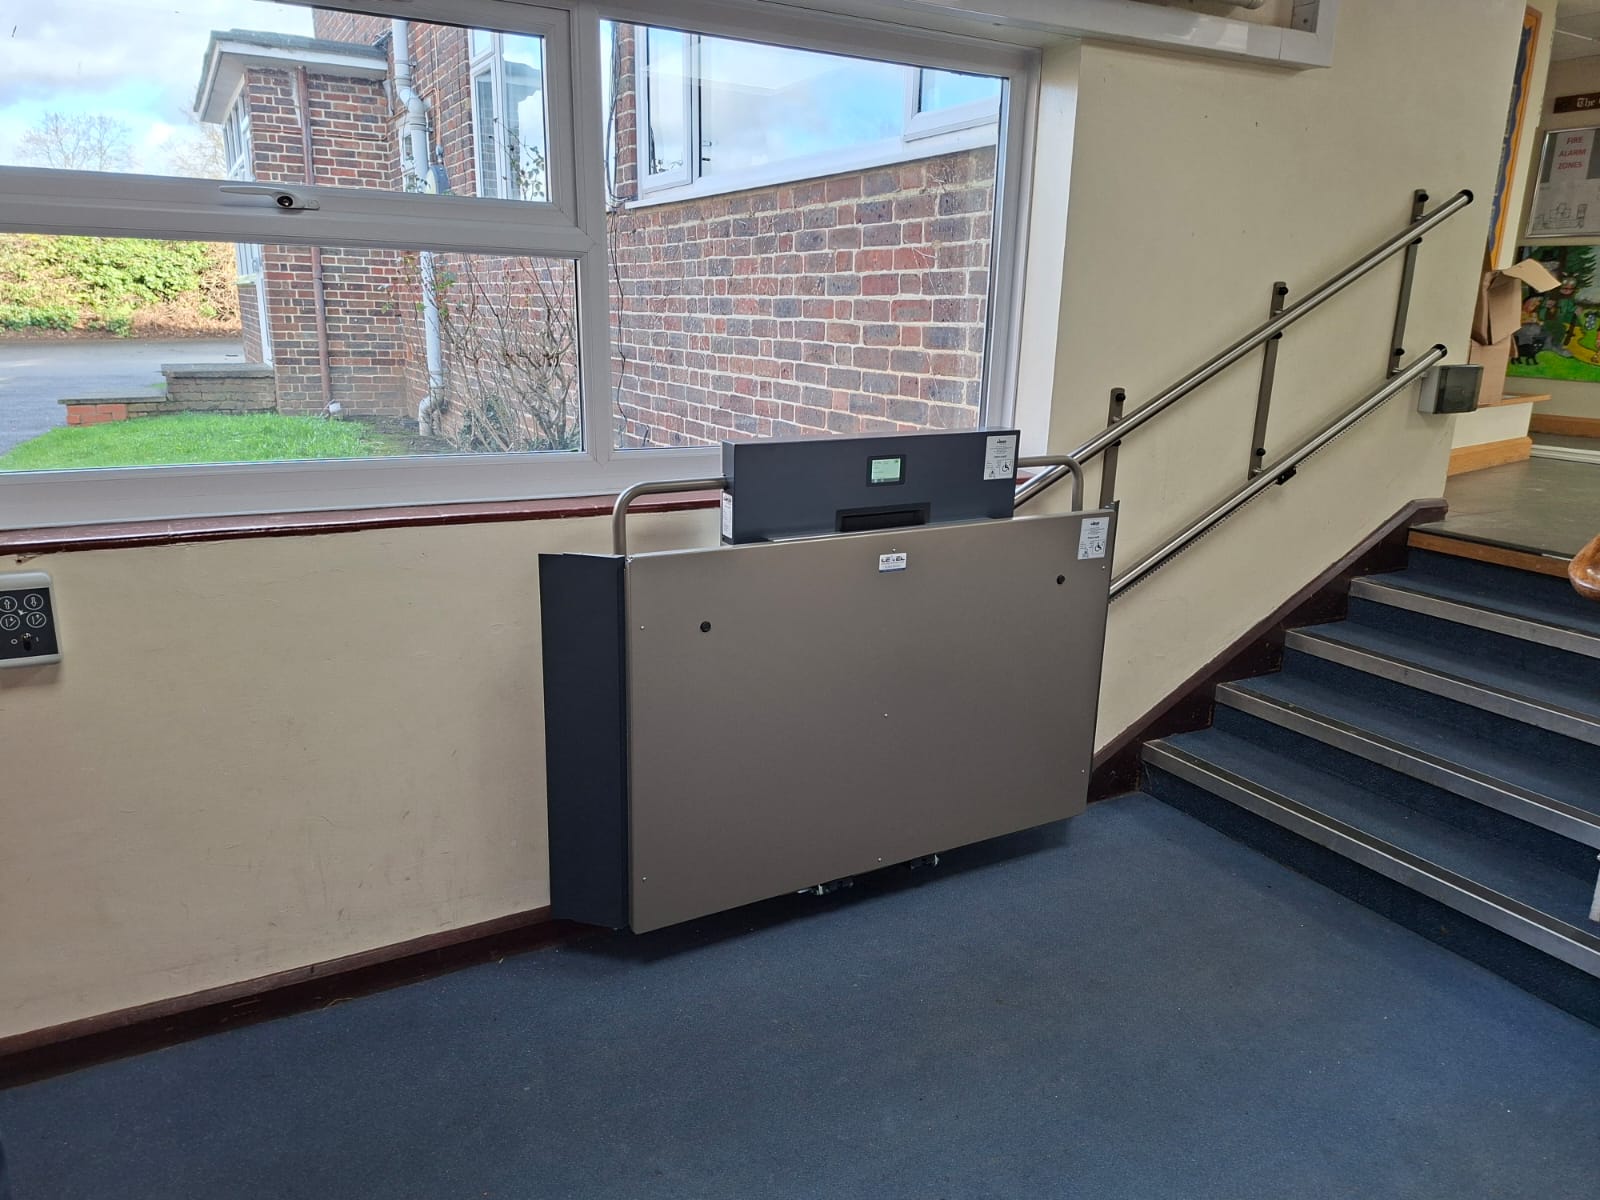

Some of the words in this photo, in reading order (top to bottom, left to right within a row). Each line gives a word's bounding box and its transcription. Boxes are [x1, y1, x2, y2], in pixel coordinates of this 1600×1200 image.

[1567, 136, 1584, 144] FIRE
[1559, 149, 1586, 157] ALARM
[1558, 162, 1583, 170] ZONES
